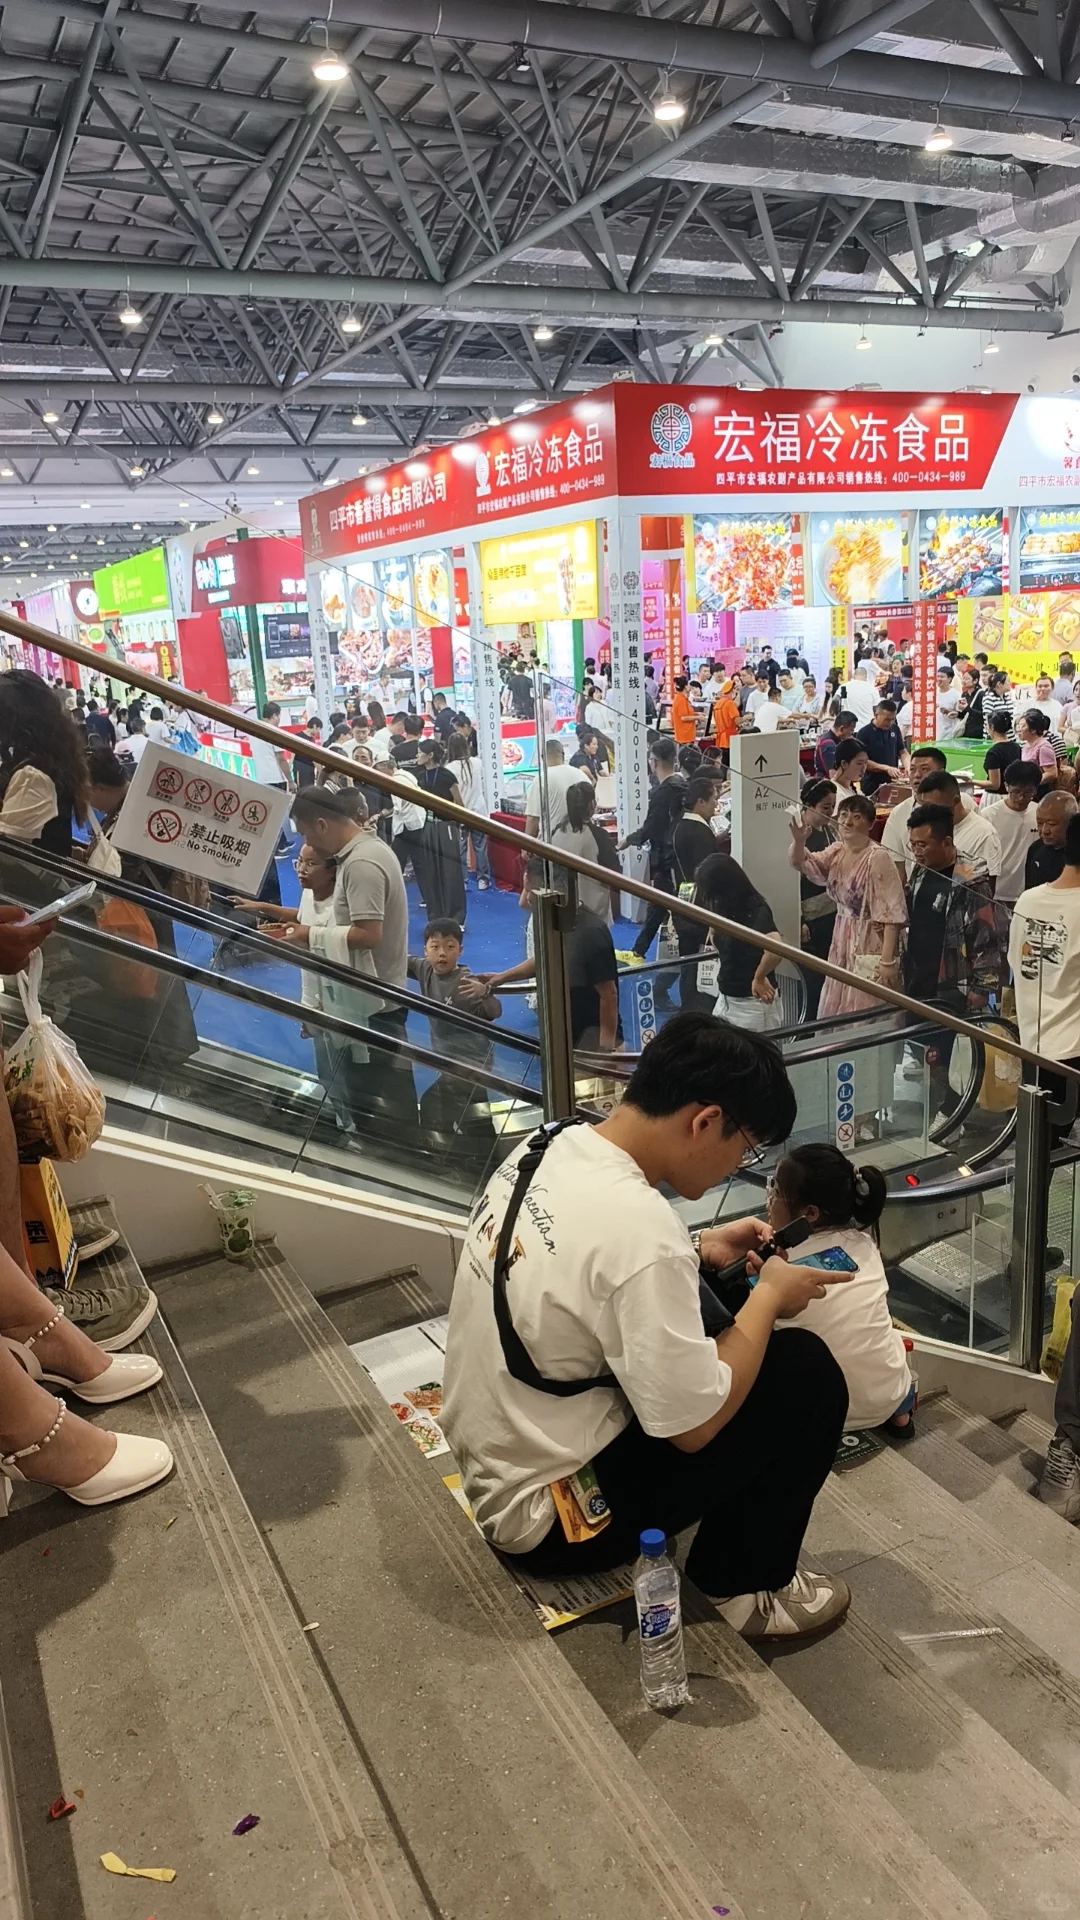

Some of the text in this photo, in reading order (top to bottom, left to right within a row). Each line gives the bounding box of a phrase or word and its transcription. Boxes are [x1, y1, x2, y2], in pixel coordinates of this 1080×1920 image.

[495, 422, 604, 487] 宏福冷冻食品
[650, 451, 696, 468] 宏福食品
[714, 410, 969, 463] 宏福冷冻食品
[329, 472, 447, 532] 四平市香誉得食品有限公司
[925, 604, 936, 743] 吉林省含含餐饮管理有限
[755, 786, 770, 799] A2
[186, 838, 243, 868] No Smoking
[190, 822, 251, 857] 禁止吸烟
[525, 1183, 557, 1256] Vacation
